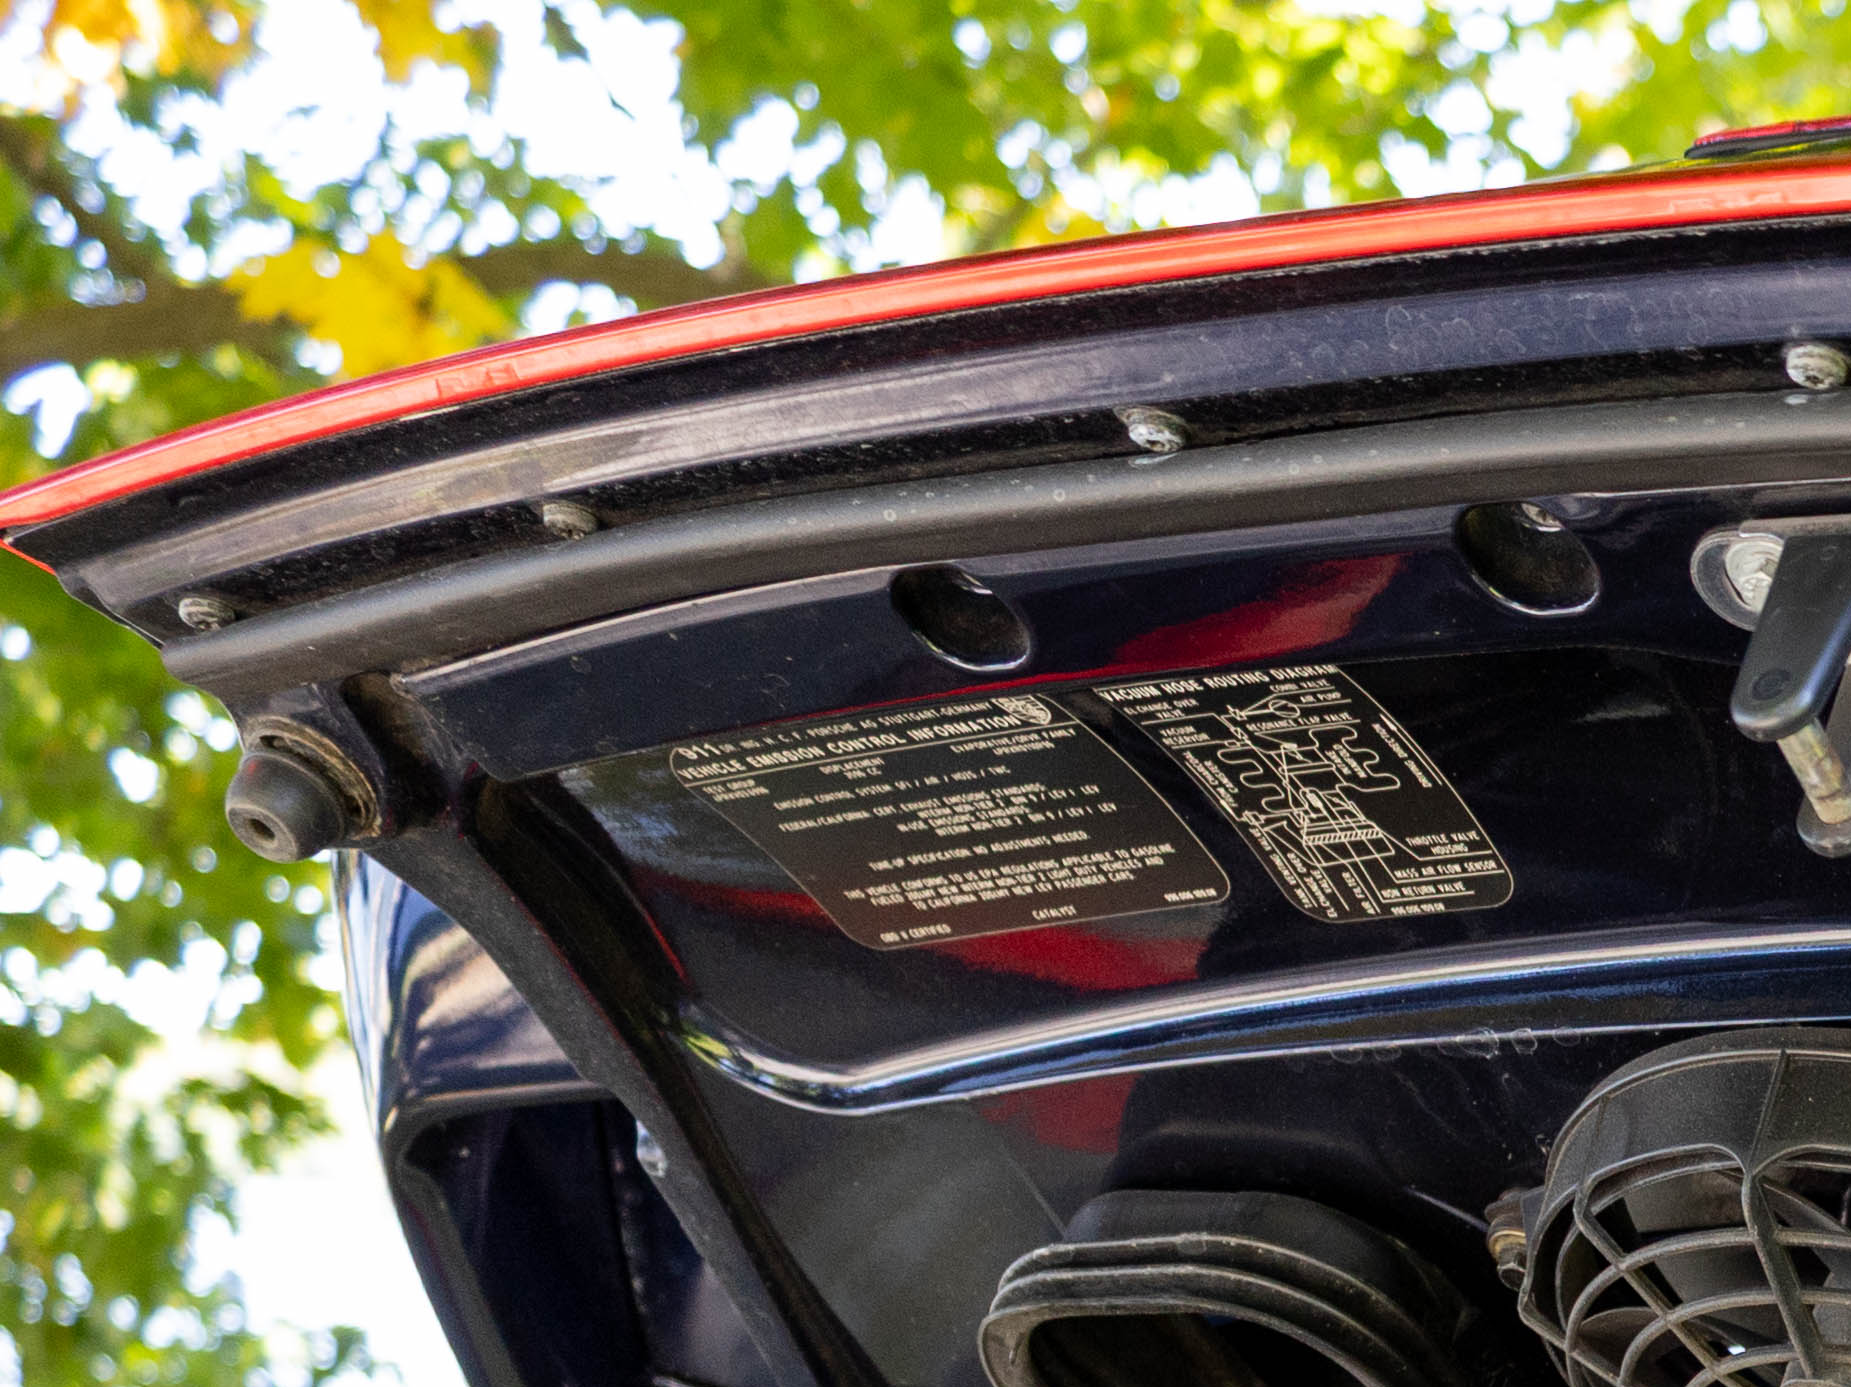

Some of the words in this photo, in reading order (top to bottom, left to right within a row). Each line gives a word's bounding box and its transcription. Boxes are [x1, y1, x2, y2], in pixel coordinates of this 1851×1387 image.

[1098, 687, 1162, 703] VACUUM
[1162, 680, 1204, 695] HOSE
[1205, 672, 1270, 690] ROUTING
[1269, 665, 1339, 681] DIAGRAM
[1301, 679, 1334, 689] VALVE
[1173, 698, 1199, 708] OVER
[1318, 691, 1342, 701] PUMP
[1156, 709, 1185, 720] VALVE
[1297, 716, 1321, 727] FLAP
[1324, 712, 1353, 722] VALVE
[805, 722, 858, 737] PORSCHE
[858, 718, 878, 729] AG
[676, 742, 721, 760] 911
[677, 759, 746, 779] VEHICLE
[745, 745, 825, 768] EMISSION
[826, 732, 907, 754] CONTROL
[906, 715, 1020, 741] INFORMATION
[772, 796, 815, 811] EMISSION
[813, 789, 856, 804] CONTROL
[899, 798, 941, 812] EXHAUST
[942, 790, 990, 805] EMISSIONS
[928, 814, 975, 827] EMISSIONS
[989, 835, 1052, 853] ADJUSTMENTS
[1406, 834, 1449, 847] THROTTLE
[1450, 830, 1480, 843] VALVE
[1430, 844, 1469, 855] HOUSING
[864, 882, 900, 896] VEHICLE
[900, 875, 948, 890] CONFORMS
[947, 872, 963, 882] TO
[962, 870, 979, 881] US
[977, 867, 999, 879] EPA
[999, 858, 1059, 874] REGULATIONS
[1061, 850, 1113, 866] APPLICABLE
[1113, 848, 1130, 859] TO
[1130, 842, 1176, 857] GASOLINE
[1394, 866, 1419, 879] MASS
[1422, 865, 1437, 876] AIR
[1438, 862, 1462, 874] FLOW
[1465, 860, 1498, 872] SENSOR
[869, 893, 904, 906] FUELED
[938, 885, 958, 894] NEW
[960, 880, 994, 891] INTERIM
[1047, 868, 1071, 879] LIGHT
[1073, 865, 1097, 875] DUTY
[1100, 858, 1143, 871] VEHICLES
[1144, 855, 1165, 866] AND
[912, 900, 928, 911] TO
[927, 893, 978, 909] CALIFORNIA
[1011, 885, 1034, 896] NEW
[1034, 882, 1053, 893] LEV
[1054, 874, 1107, 890] PASSENGER
[1381, 887, 1401, 899] NON
[1403, 885, 1437, 897] RETURN
[1439, 882, 1466, 894] VALVE
[1031, 905, 1077, 920] CATALYST
[908, 923, 952, 939] CERTIFIED
